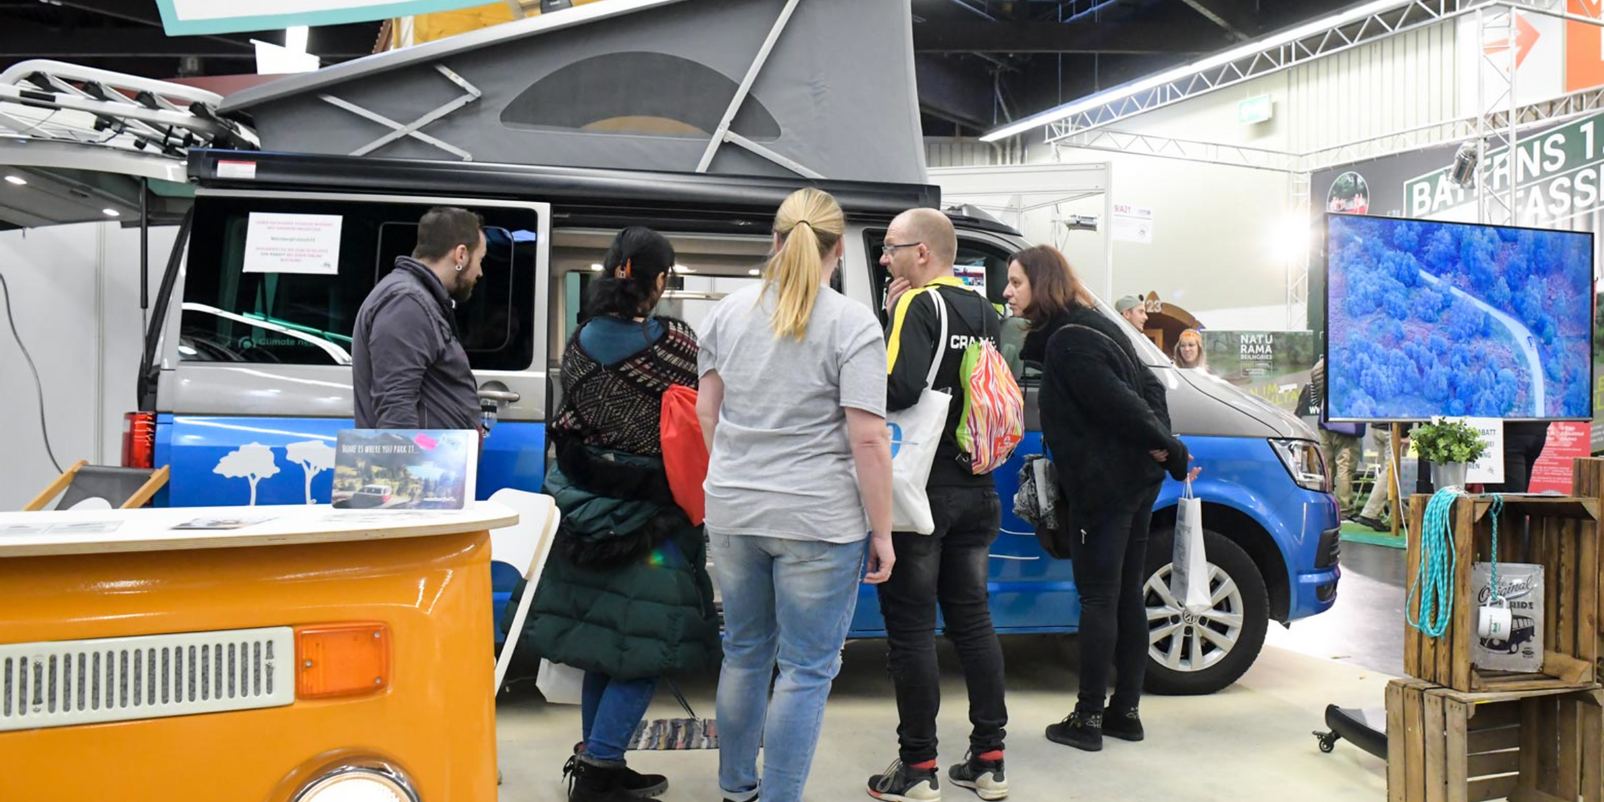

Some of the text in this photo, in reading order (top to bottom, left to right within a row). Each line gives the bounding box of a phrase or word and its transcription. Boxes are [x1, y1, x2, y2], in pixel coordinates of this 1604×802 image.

[1146, 299, 1162, 313] 23
[1240, 334, 1273, 344] NATU
[1240, 344, 1273, 354] RAMA
[1478, 574, 1534, 604] Oiginal
[1509, 600, 1534, 610] RIDE
